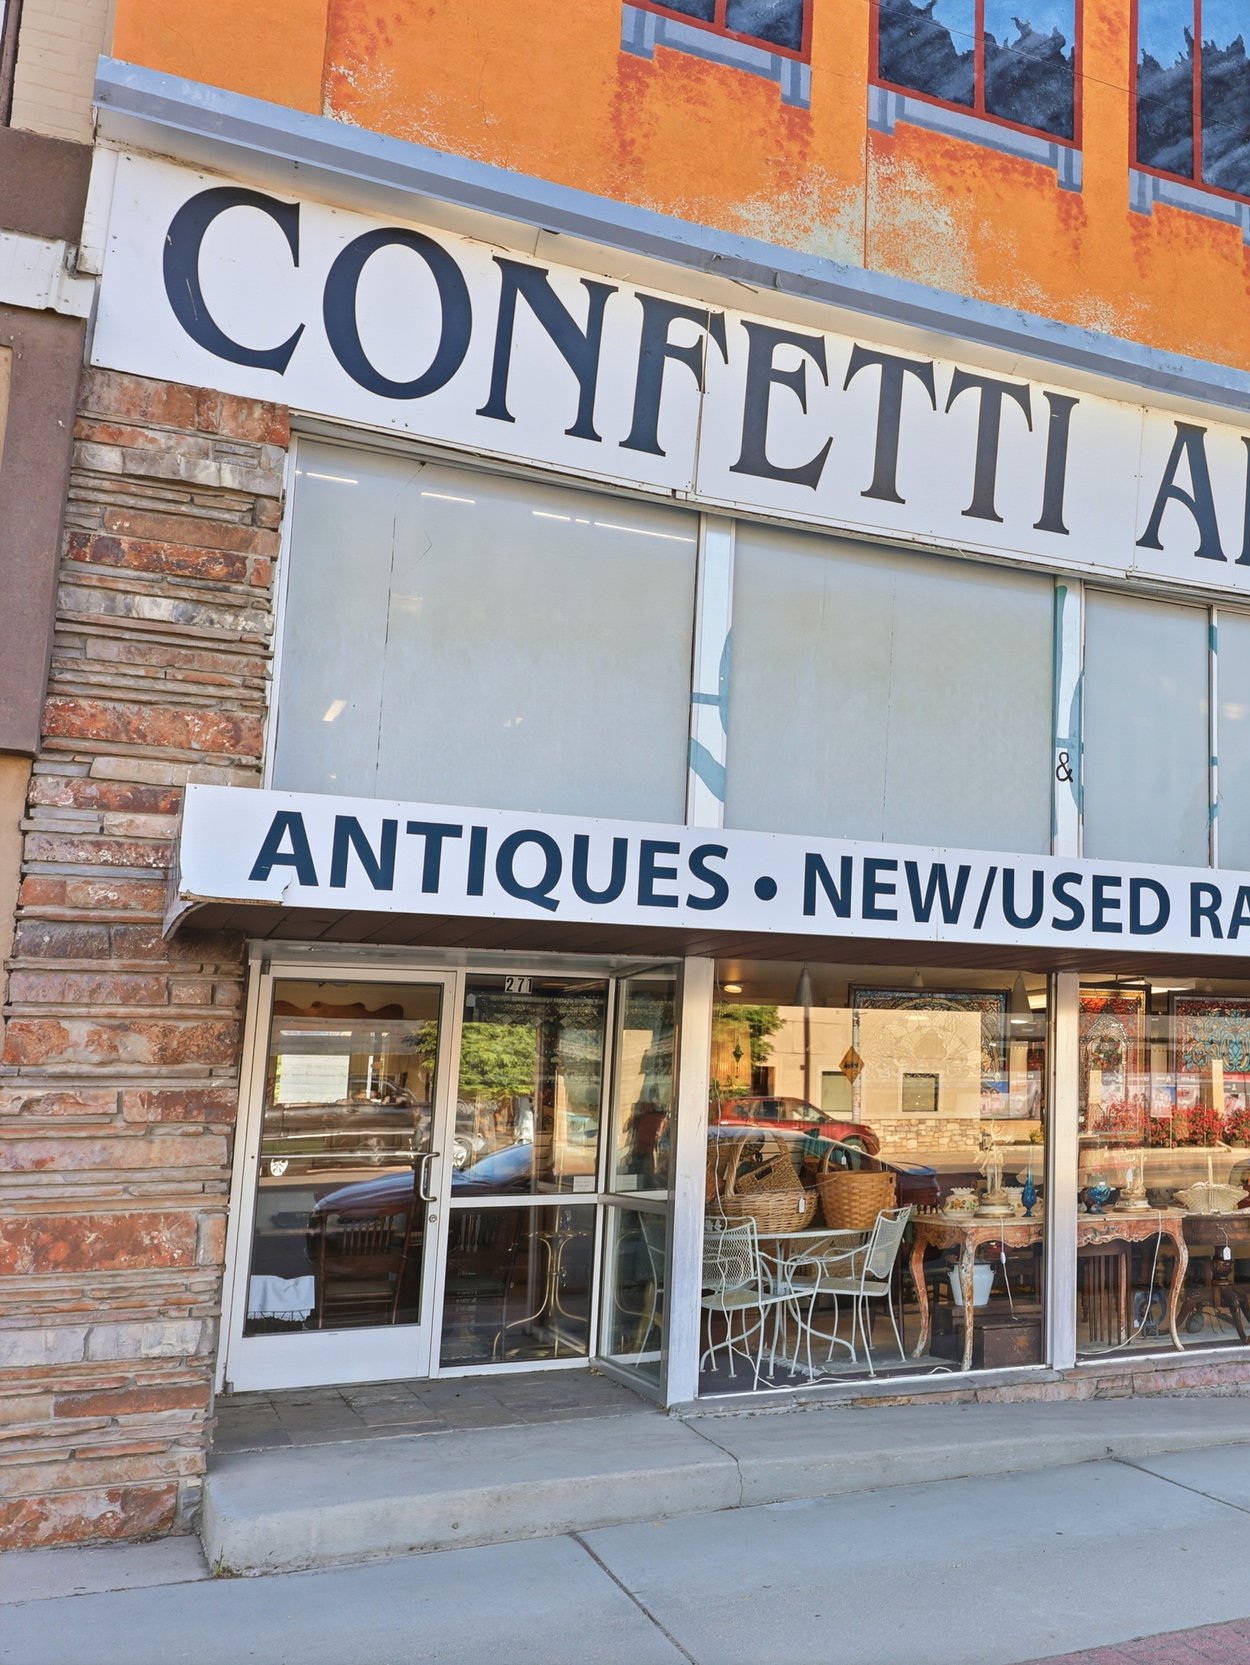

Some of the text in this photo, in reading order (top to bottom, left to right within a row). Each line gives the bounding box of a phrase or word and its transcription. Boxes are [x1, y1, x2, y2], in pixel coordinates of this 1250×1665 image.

[163, 186, 1080, 535] CONFETTI
[1056, 751, 1074, 782] &
[248, 811, 729, 912] ANTIQUES
[802, 852, 1170, 935] NEW/USED
[506, 977, 532, 992] 271
